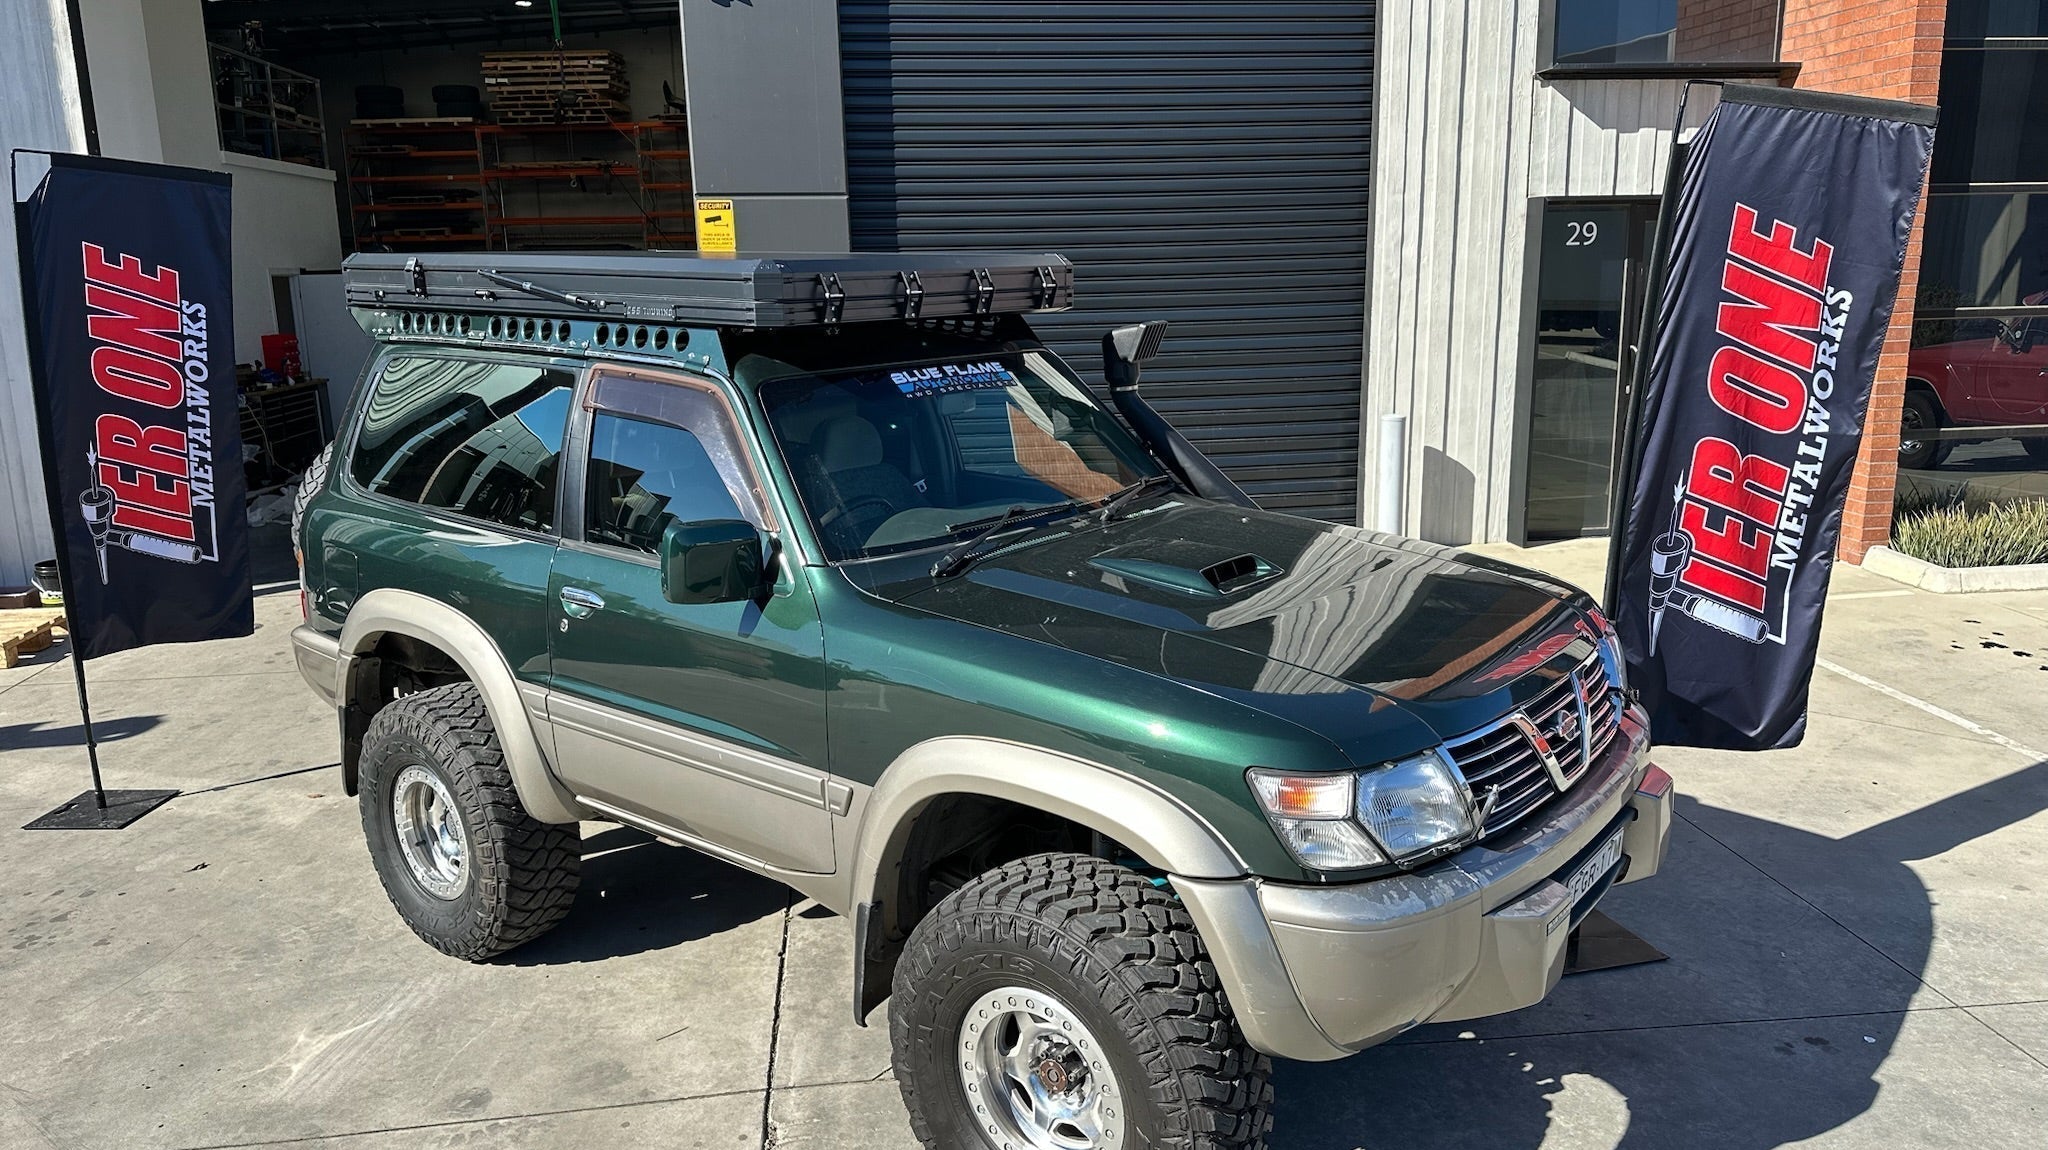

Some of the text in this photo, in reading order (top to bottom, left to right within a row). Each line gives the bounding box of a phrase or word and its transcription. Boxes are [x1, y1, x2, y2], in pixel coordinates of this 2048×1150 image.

[699, 202, 731, 210] SECURITY
[1565, 221, 1598, 246] 29
[82, 241, 185, 410] ONE
[890, 361, 1005, 385] BLUE FLAME
[1706, 202, 1835, 435] ONE
[181, 300, 216, 507] METALWORKS
[1770, 286, 1854, 569] METALWORKS
